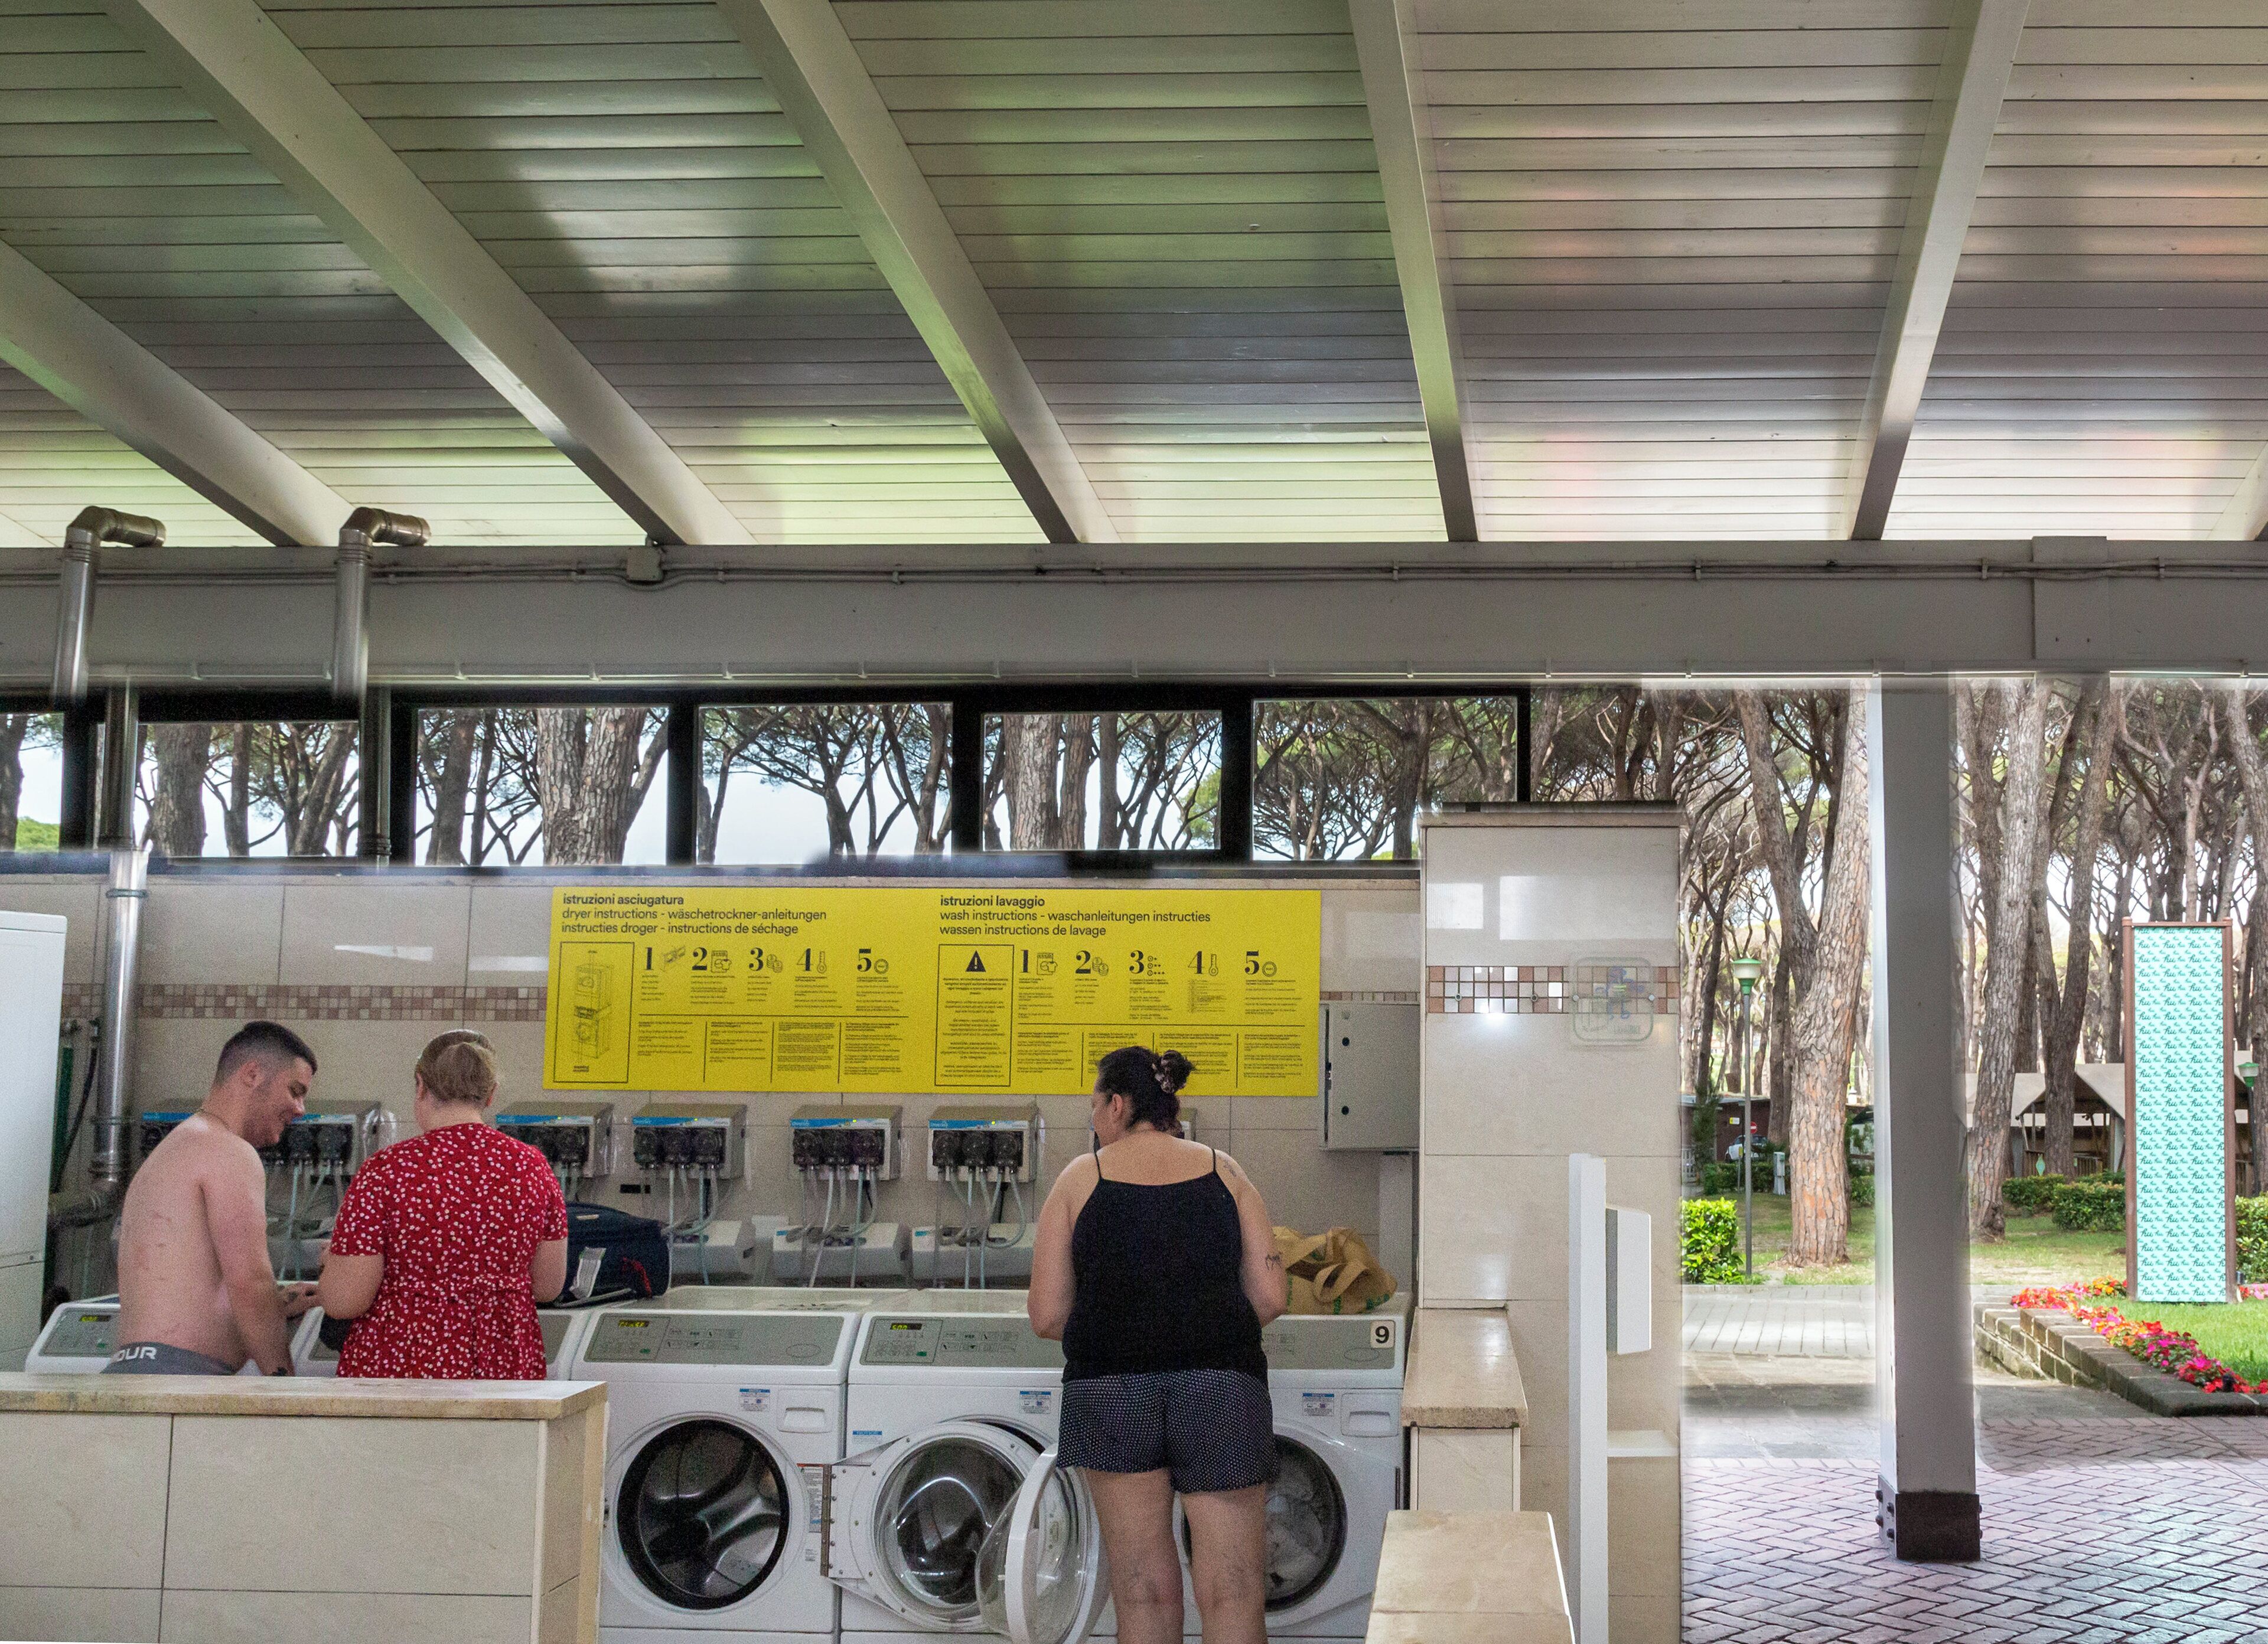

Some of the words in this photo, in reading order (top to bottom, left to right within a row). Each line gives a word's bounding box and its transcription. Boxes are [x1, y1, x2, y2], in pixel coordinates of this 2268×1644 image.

[563, 893, 615, 905] istruzioni
[618, 894, 684, 907] asciugatura
[940, 895, 993, 906] istruzioni
[996, 895, 1045, 909] lavaggio
[562, 908, 591, 920] dryer
[594, 908, 657, 919] instructions
[668, 908, 826, 922] wäschetrockner-anleitungen
[940, 909, 969, 921] wash
[973, 910, 1037, 921] instructions
[1048, 910, 1149, 924] waschanleitungen
[1153, 911, 1210, 922] instructies
[562, 922, 617, 933] instructies
[621, 922, 657, 935] droger
[668, 922, 732, 934] instructions
[735, 922, 749, 934] de
[752, 923, 799, 936] séchage
[940, 926, 982, 935] wassen
[985, 924, 1049, 935] instructions
[1052, 925, 1067, 935] de
[1070, 925, 1106, 938] lavage
[644, 947, 653, 970] 1
[692, 947, 708, 970] 2
[749, 947, 764, 971] 3
[797, 948, 812, 971] 4
[857, 948, 872, 972] 5
[1021, 950, 1029, 973] 1
[1076, 950, 1091, 974] 2
[1129, 950, 1145, 974] 3
[1188, 951, 1203, 974] 4
[1244, 950, 1260, 975] 5
[1376, 1326, 1390, 1344] 9
